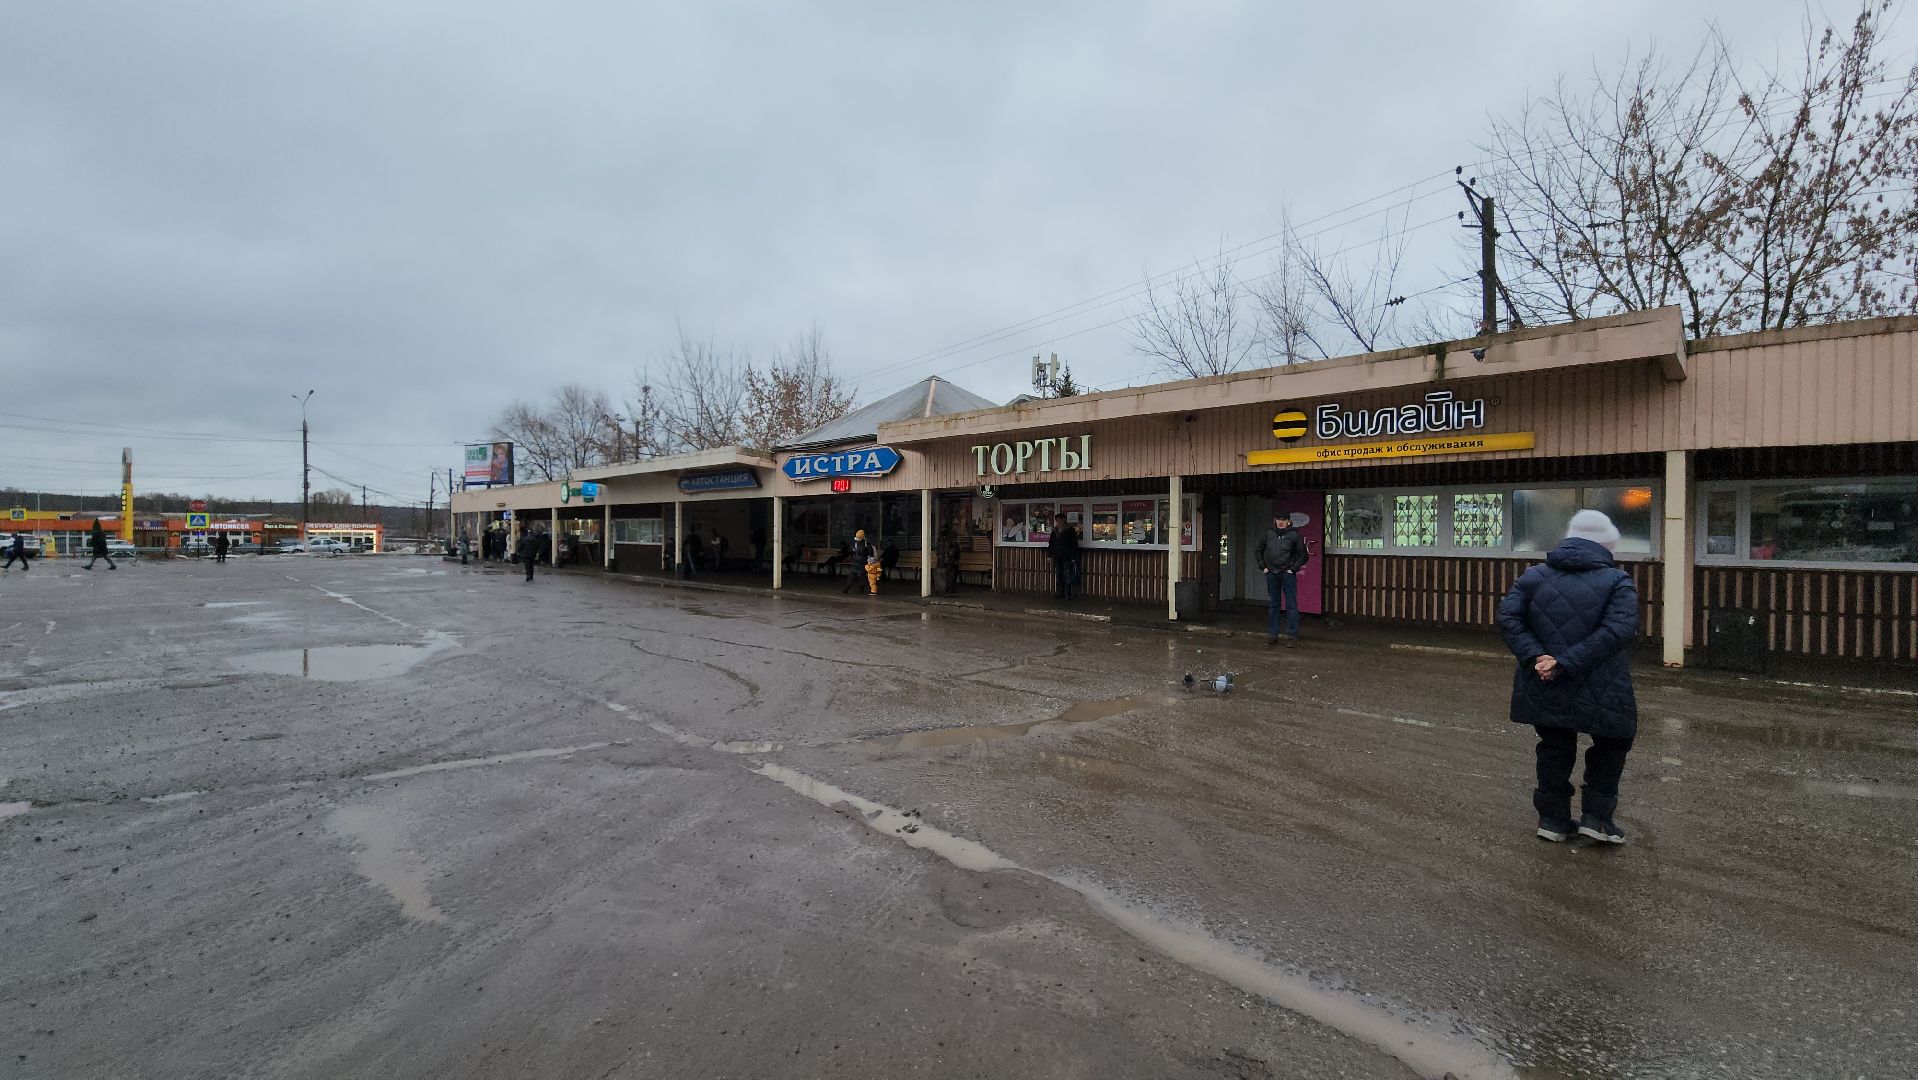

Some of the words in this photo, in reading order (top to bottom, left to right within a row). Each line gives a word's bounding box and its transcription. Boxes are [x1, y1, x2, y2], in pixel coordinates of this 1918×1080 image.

[1316, 391, 1485, 440] Билайн
[794, 451, 882, 475] ИСТРА
[971, 434, 1094, 476] ТОРТЫ
[1316, 448, 1342, 458] офис
[1343, 446, 1383, 457] продаж
[1386, 445, 1393, 453] и
[1396, 439, 1484, 452] обслуживания
